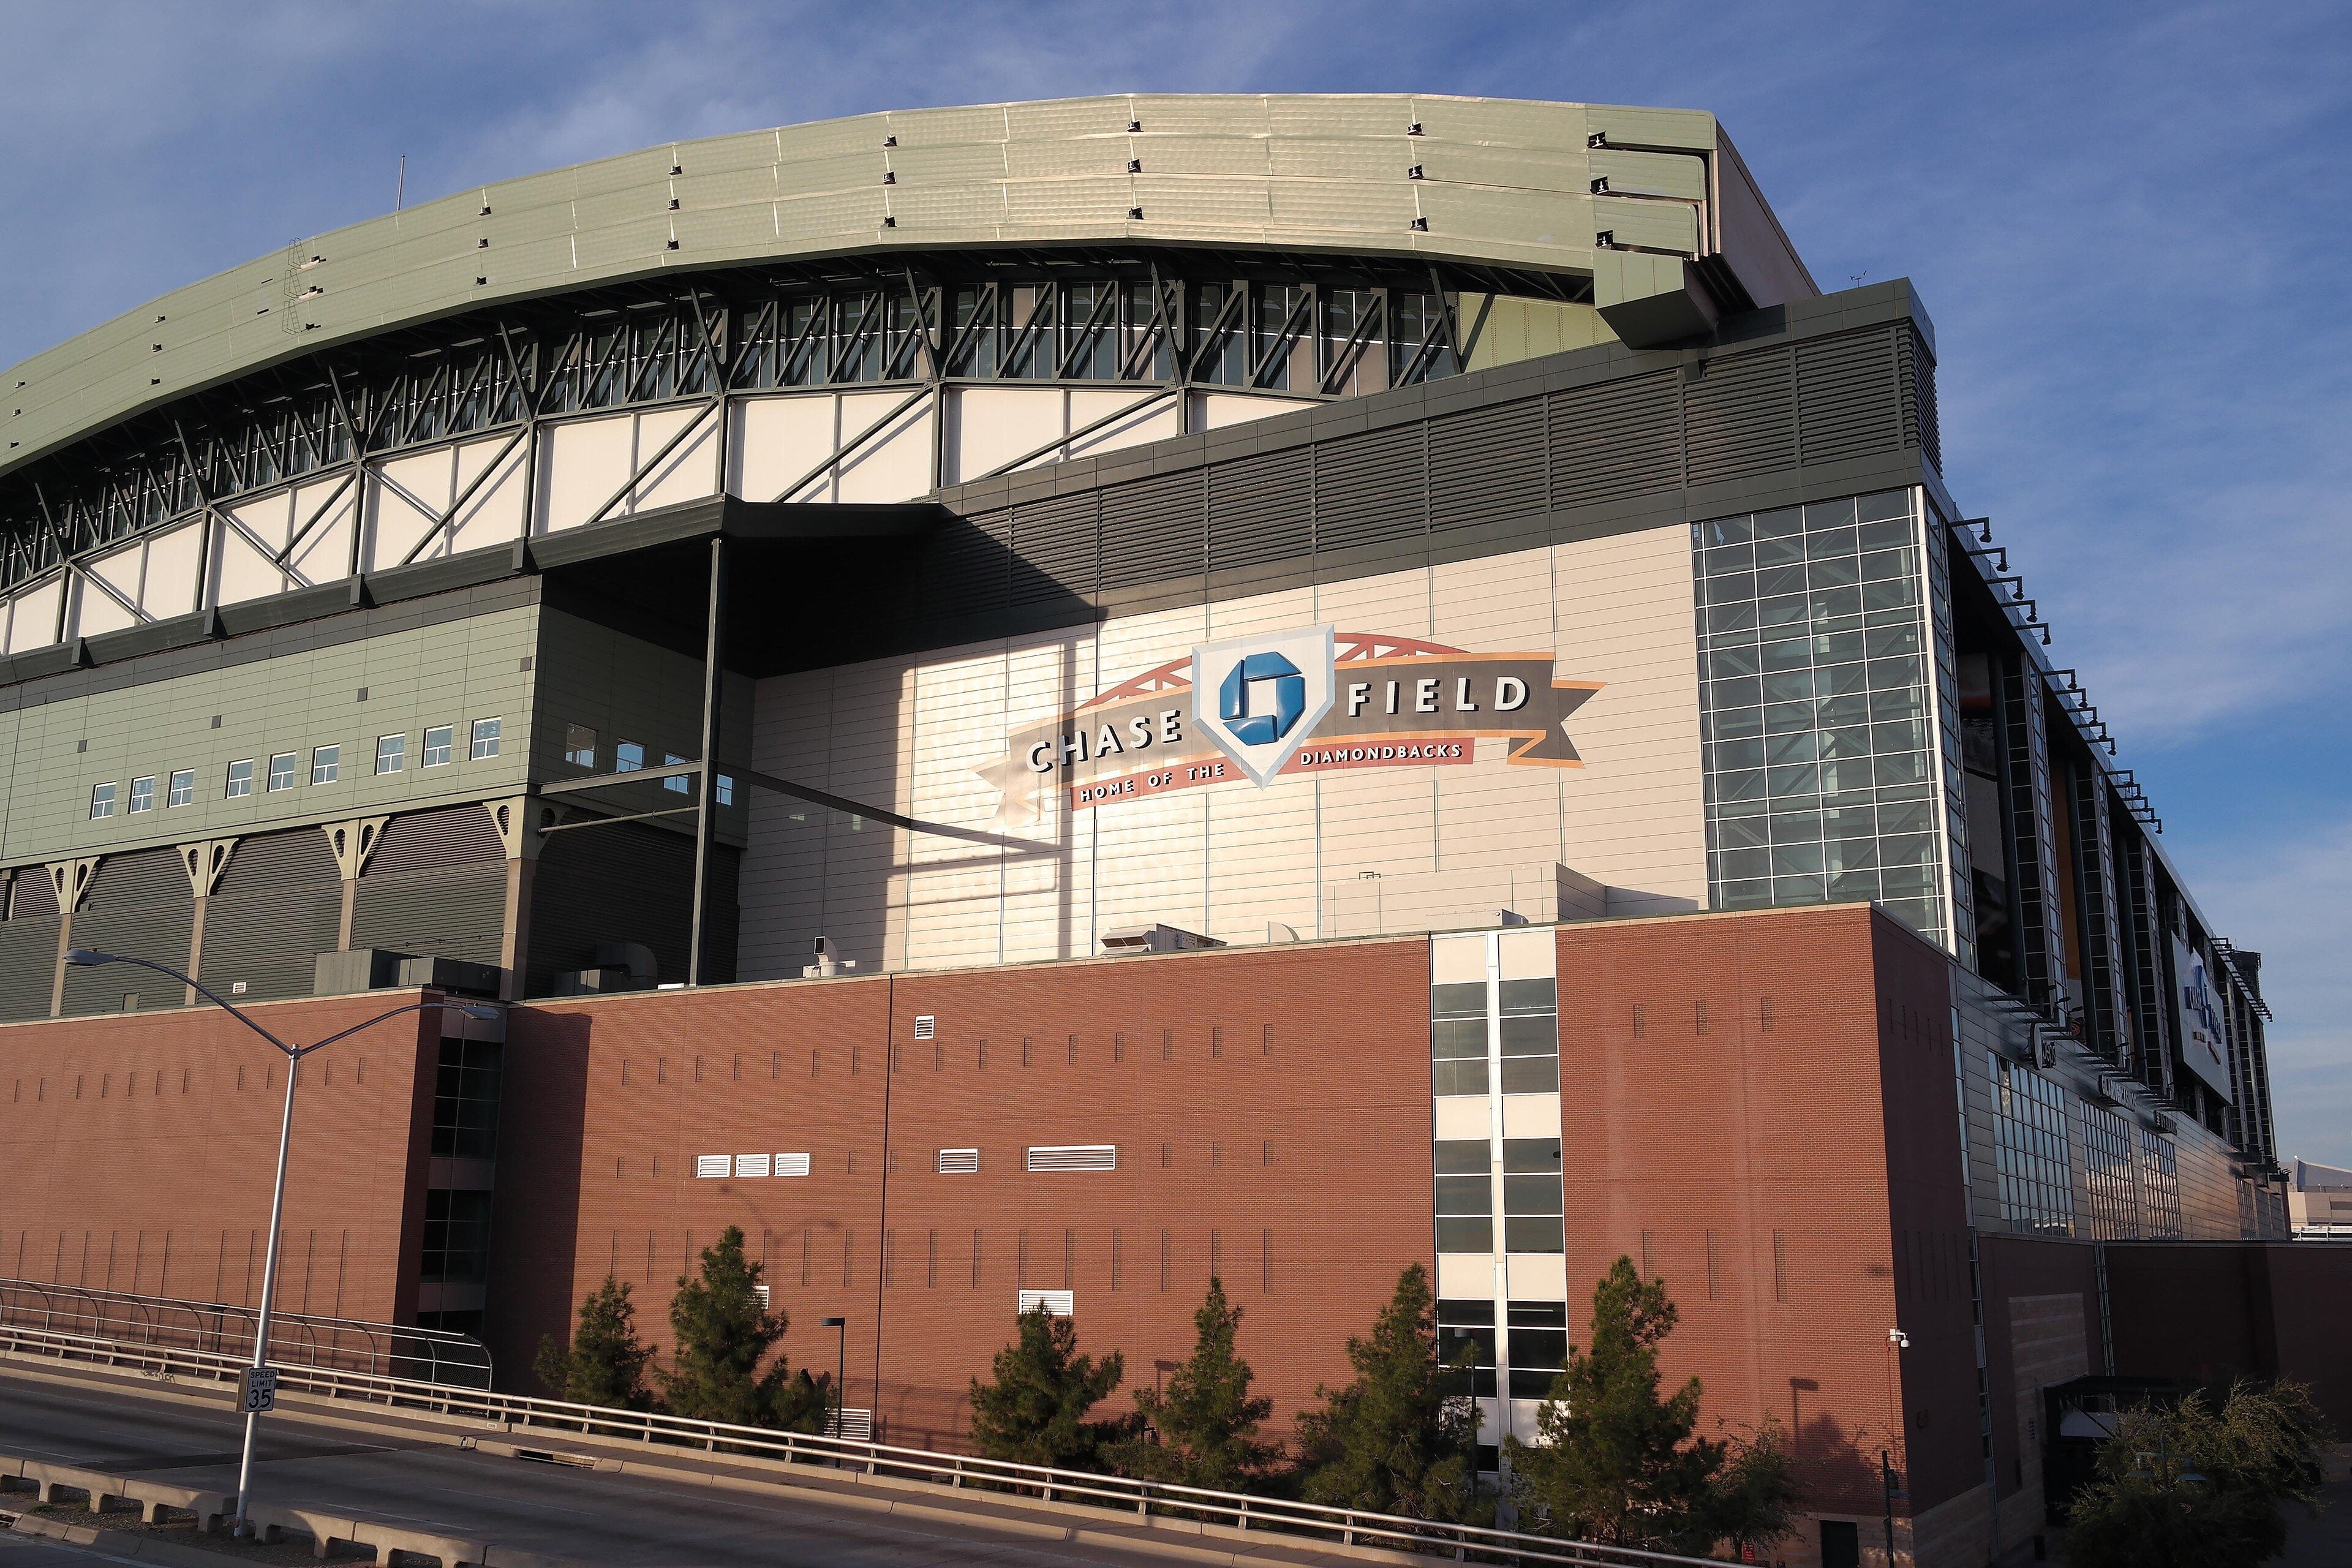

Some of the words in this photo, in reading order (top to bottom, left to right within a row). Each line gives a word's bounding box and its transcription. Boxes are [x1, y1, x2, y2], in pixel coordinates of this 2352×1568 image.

[1026, 709, 1182, 774] CHASE
[1348, 676, 1531, 717] FIELD
[1080, 780, 1134, 802] HOME
[1148, 772, 1172, 787] OF
[1186, 763, 1224, 780] THE
[1300, 744, 1463, 766] DIAMONDBACKS
[248, 1389, 271, 1409] 35
